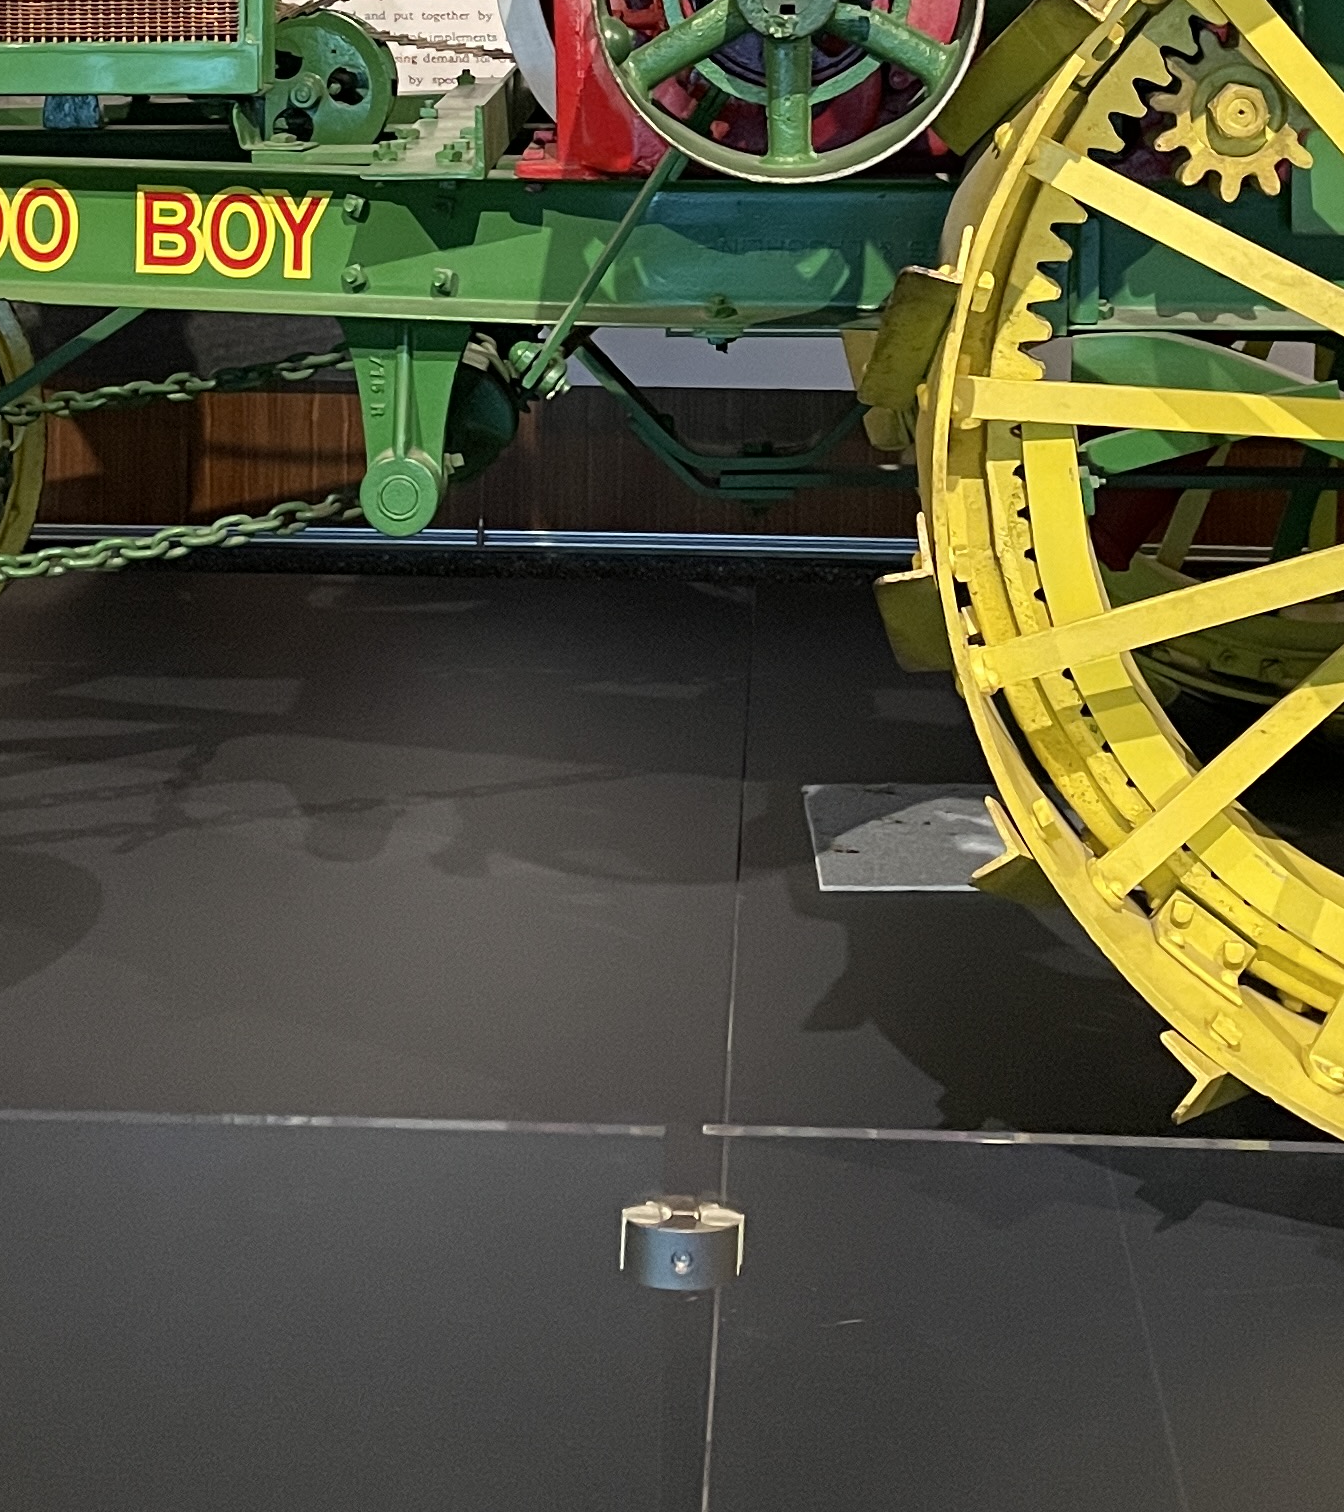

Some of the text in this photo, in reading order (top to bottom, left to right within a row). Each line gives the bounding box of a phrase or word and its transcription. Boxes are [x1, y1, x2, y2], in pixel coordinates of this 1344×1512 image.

[394, 12, 413, 23] put
[421, 11, 470, 22] together
[478, 11, 493, 22] by
[423, 53, 469, 64] demand
[408, 75, 424, 86] by
[134, 186, 333, 281] BOY
